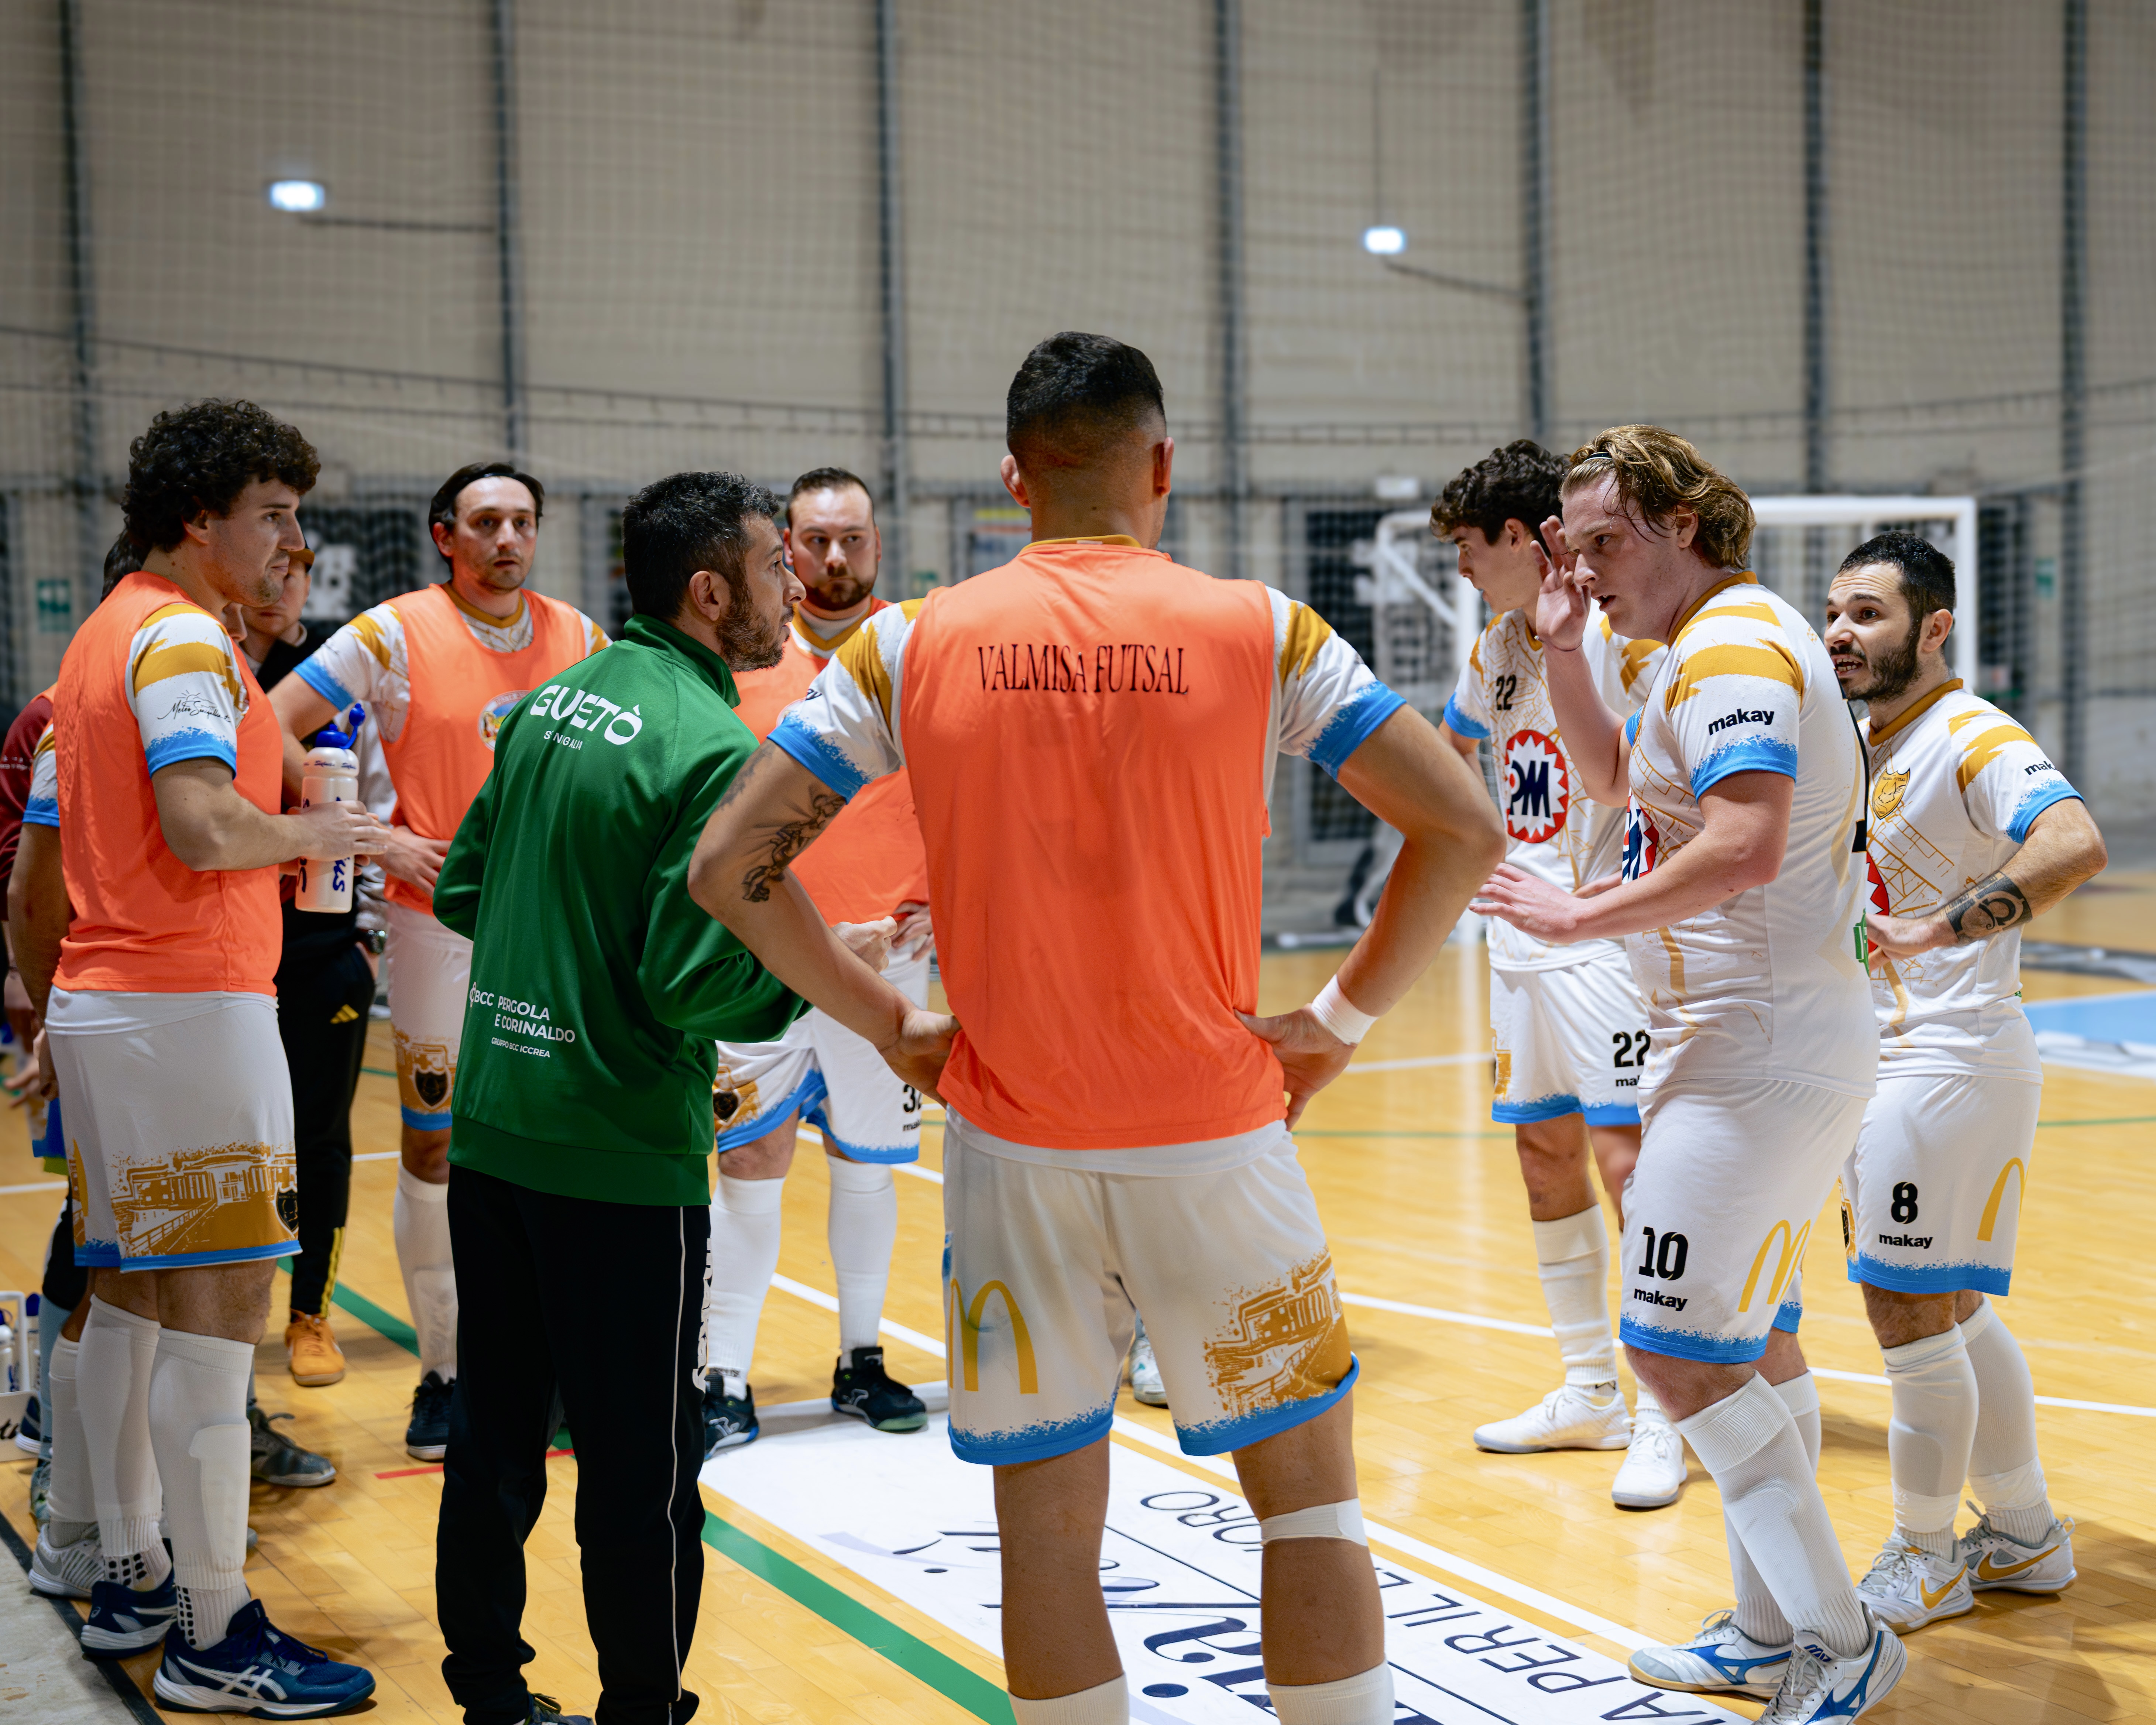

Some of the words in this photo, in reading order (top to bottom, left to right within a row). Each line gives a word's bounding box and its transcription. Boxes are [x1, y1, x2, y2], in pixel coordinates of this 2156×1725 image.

[978, 643, 1087, 693] VALMISA
[1094, 644, 1189, 695] FUTSAL
[1496, 674, 1517, 710] 22
[530, 685, 643, 745] GUSTÒ
[1708, 708, 1775, 736] makay
[2024, 761, 2055, 775] mak
[474, 990, 495, 1006] BCC
[497, 995, 550, 1021] PERGOLA
[494, 1013, 501, 1027] E
[501, 1015, 576, 1043] CORINALDO
[491, 1037, 509, 1048] GRUPPO
[509, 1042, 519, 1051] BCC
[519, 1045, 550, 1058] ICCREA
[1613, 1029, 1651, 1068] 22
[903, 1084, 922, 1113] 3
[1891, 1182, 1918, 1224] 8
[1638, 1226, 1689, 1281] 10
[1879, 1234, 1933, 1249] makay
[1634, 1288, 1689, 1312] makay
[1386, 1593, 1483, 1628] IL
[1444, 1624, 1629, 1694] PER
